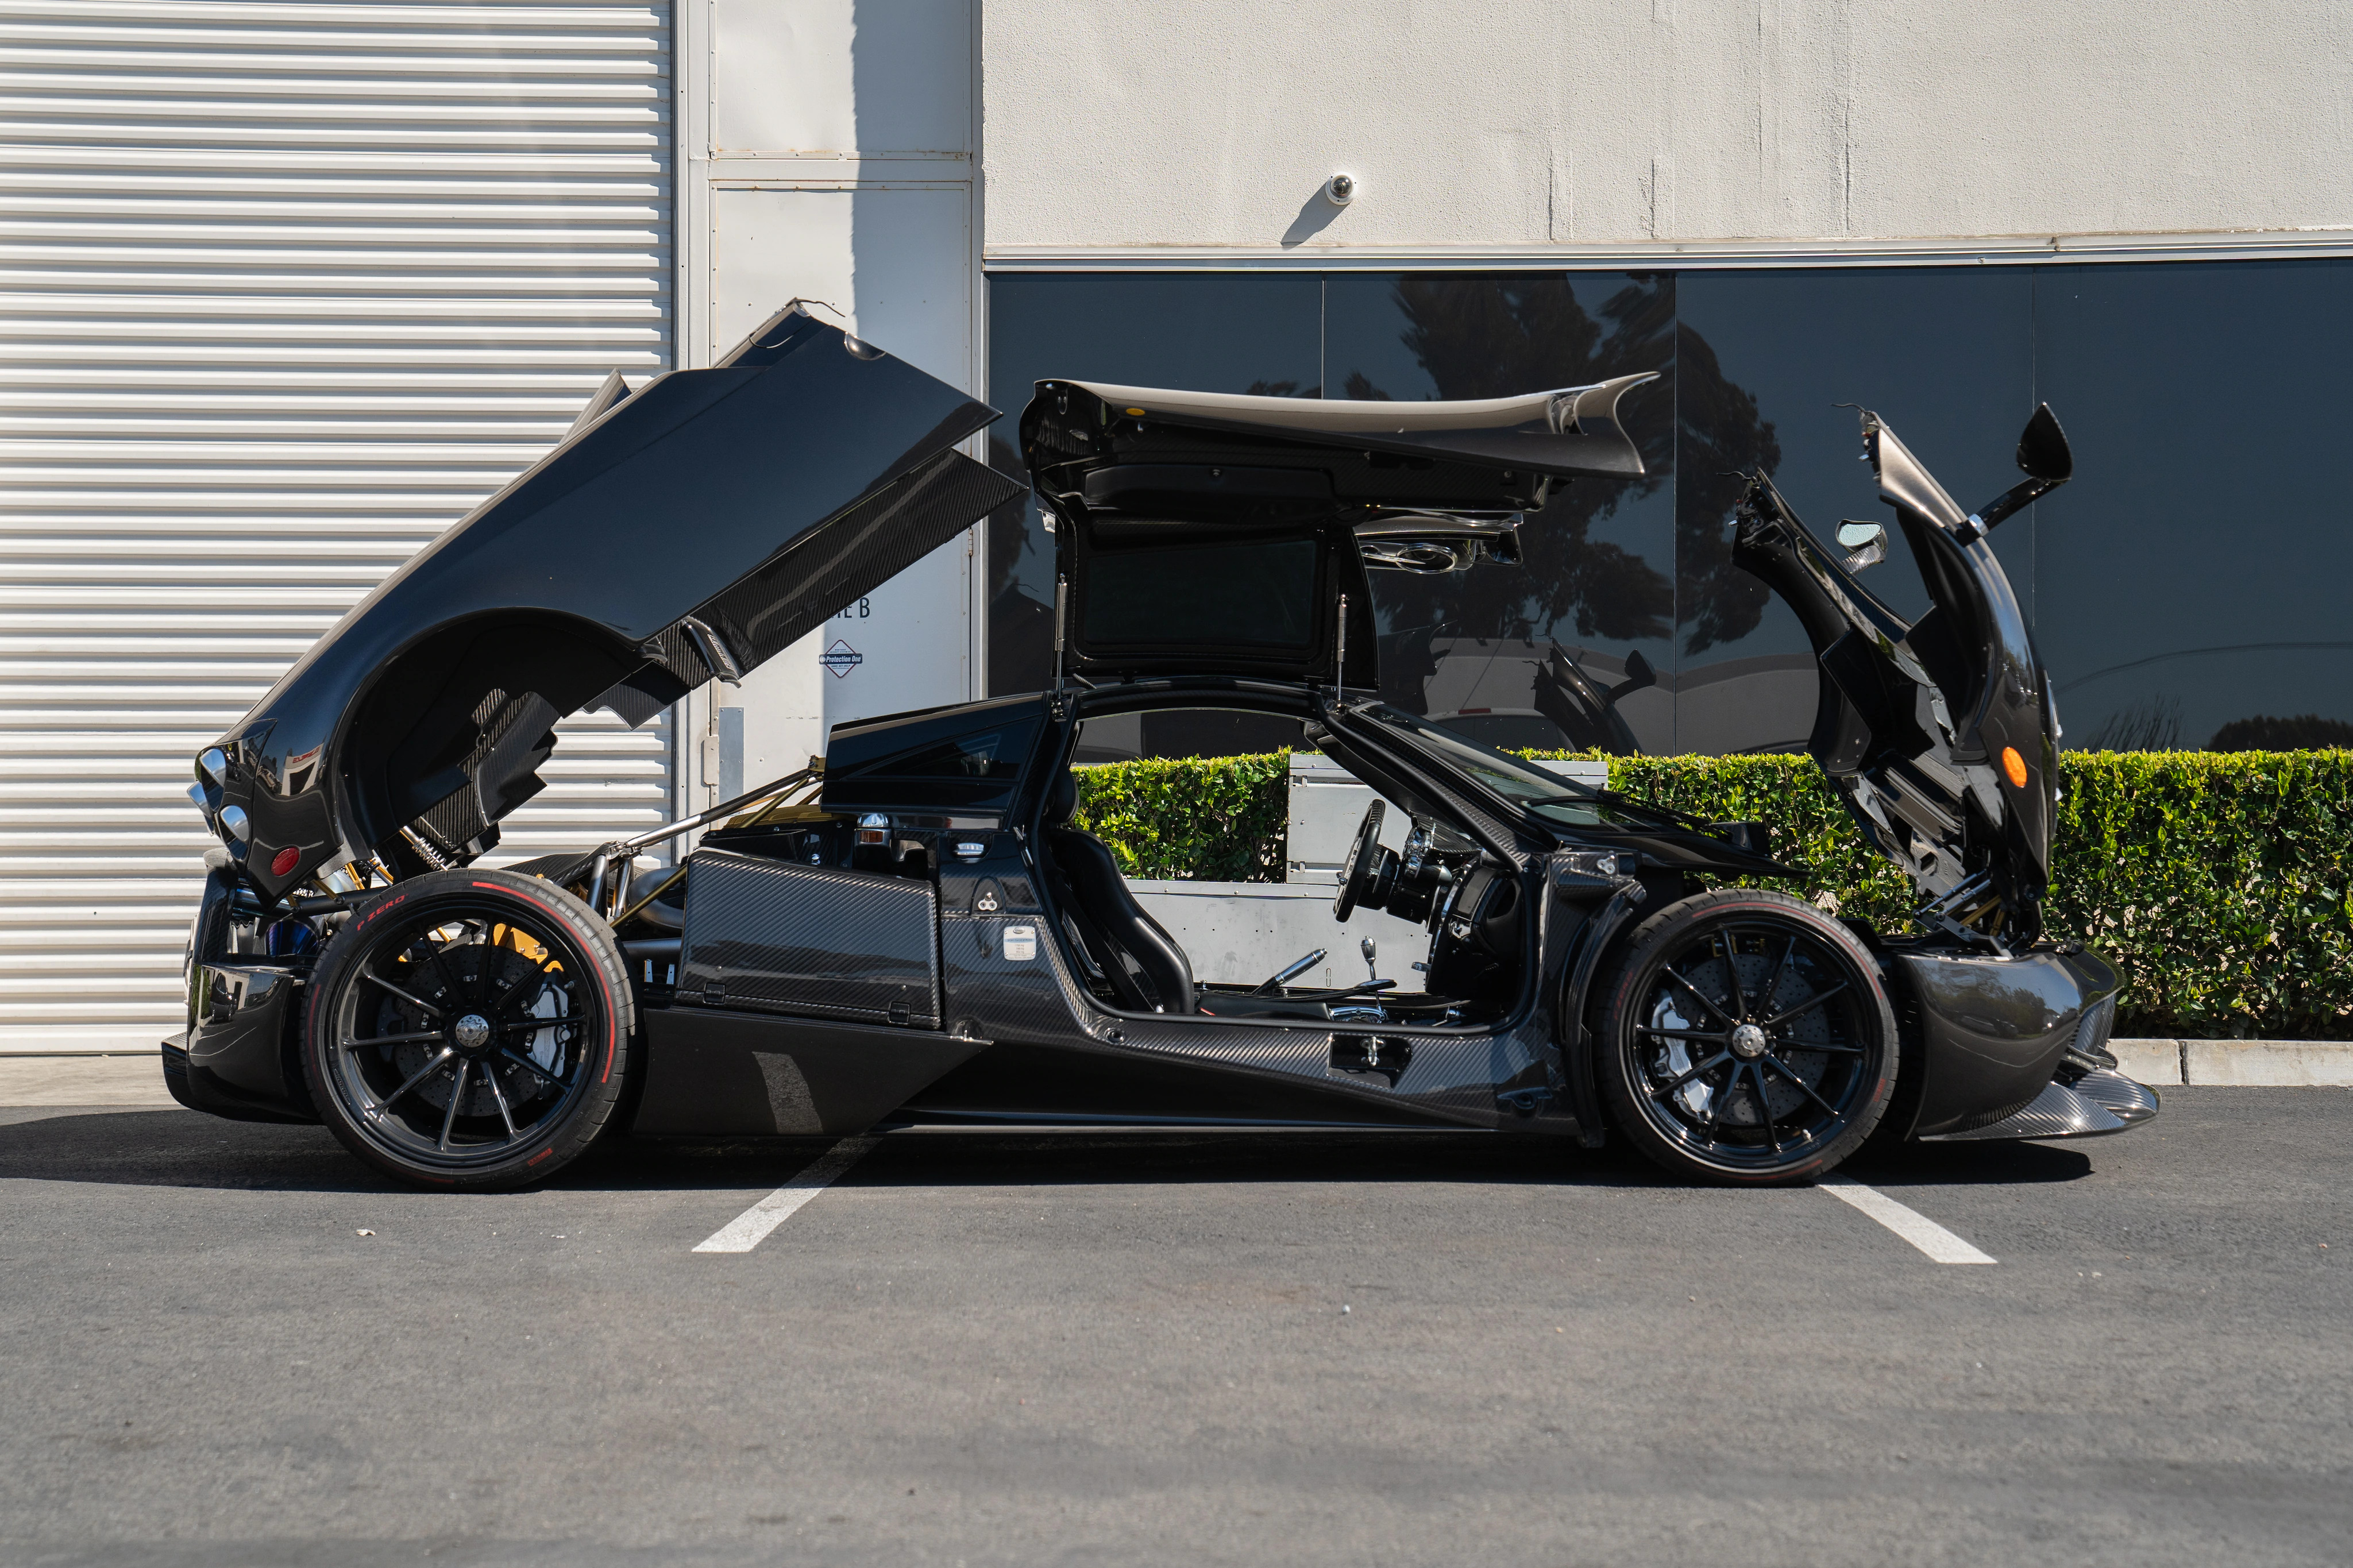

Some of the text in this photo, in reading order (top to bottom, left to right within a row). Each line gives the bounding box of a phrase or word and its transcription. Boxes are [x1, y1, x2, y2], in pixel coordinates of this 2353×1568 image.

[859, 597, 870, 618] B
[357, 895, 405, 931] P ZERO
